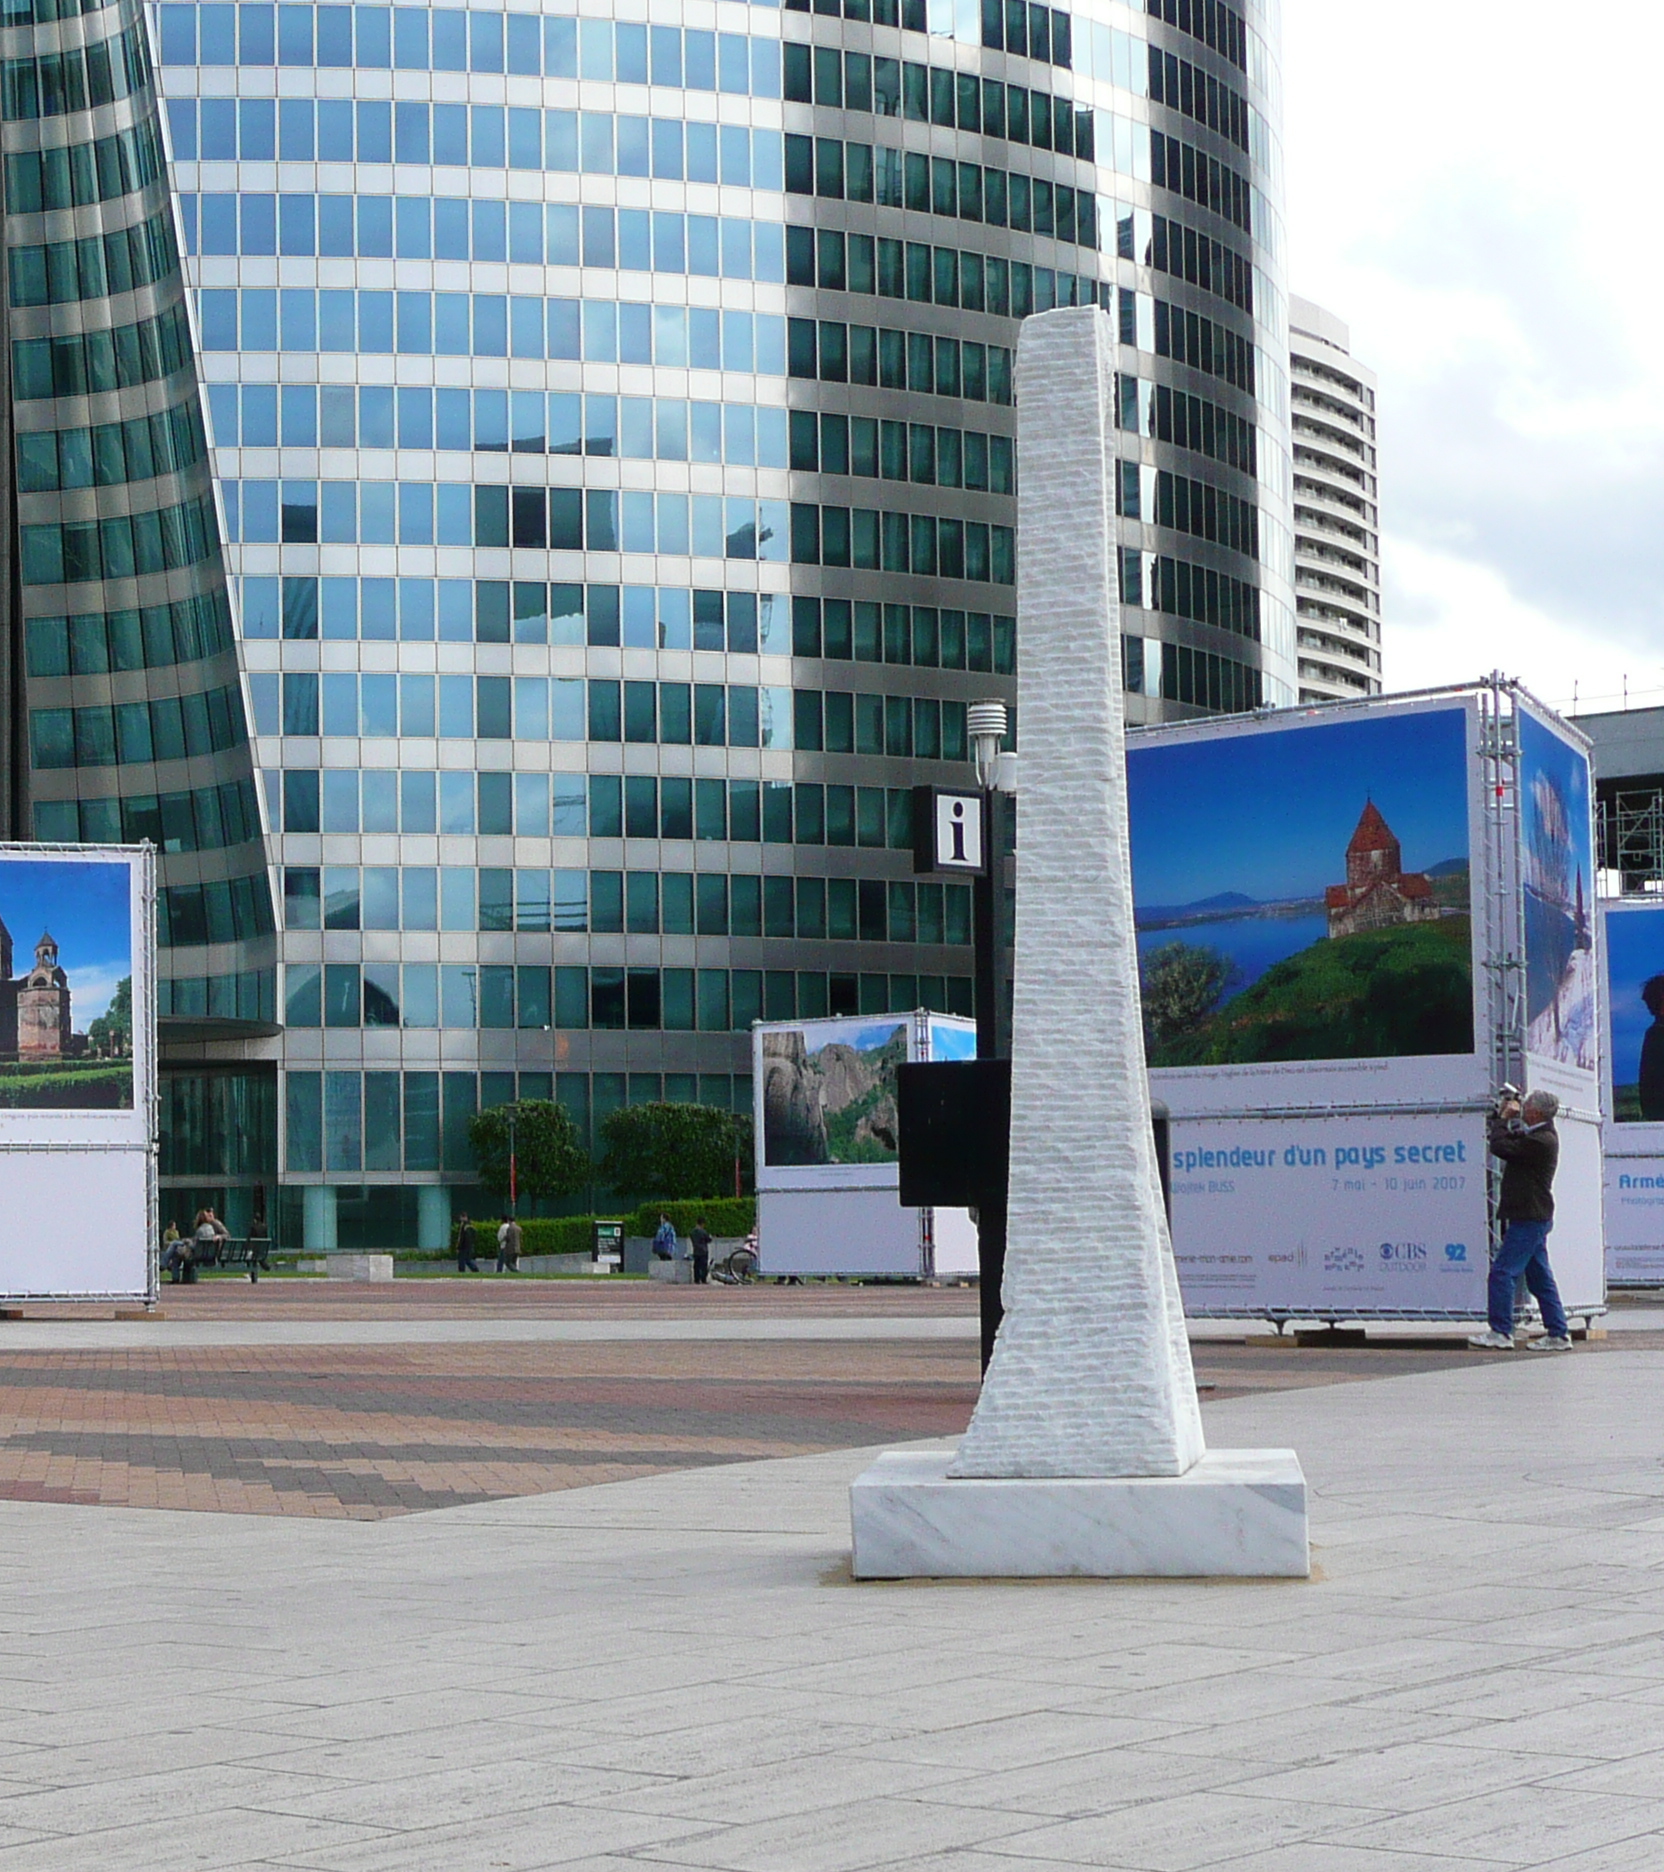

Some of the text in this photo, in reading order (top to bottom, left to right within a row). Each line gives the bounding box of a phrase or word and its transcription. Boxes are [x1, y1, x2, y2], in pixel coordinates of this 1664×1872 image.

[948, 801, 970, 861] i
[1173, 1140, 1466, 1173] splendeur d'un pays secret
[1385, 1177, 1398, 1191] 10
[1403, 1178, 1426, 1192] juin
[1433, 1176, 1466, 1191] 2007
[1395, 1243, 1427, 1259] CBS
[1445, 1243, 1467, 1261] 92
[1380, 1262, 1427, 1272] OUTDOOR
